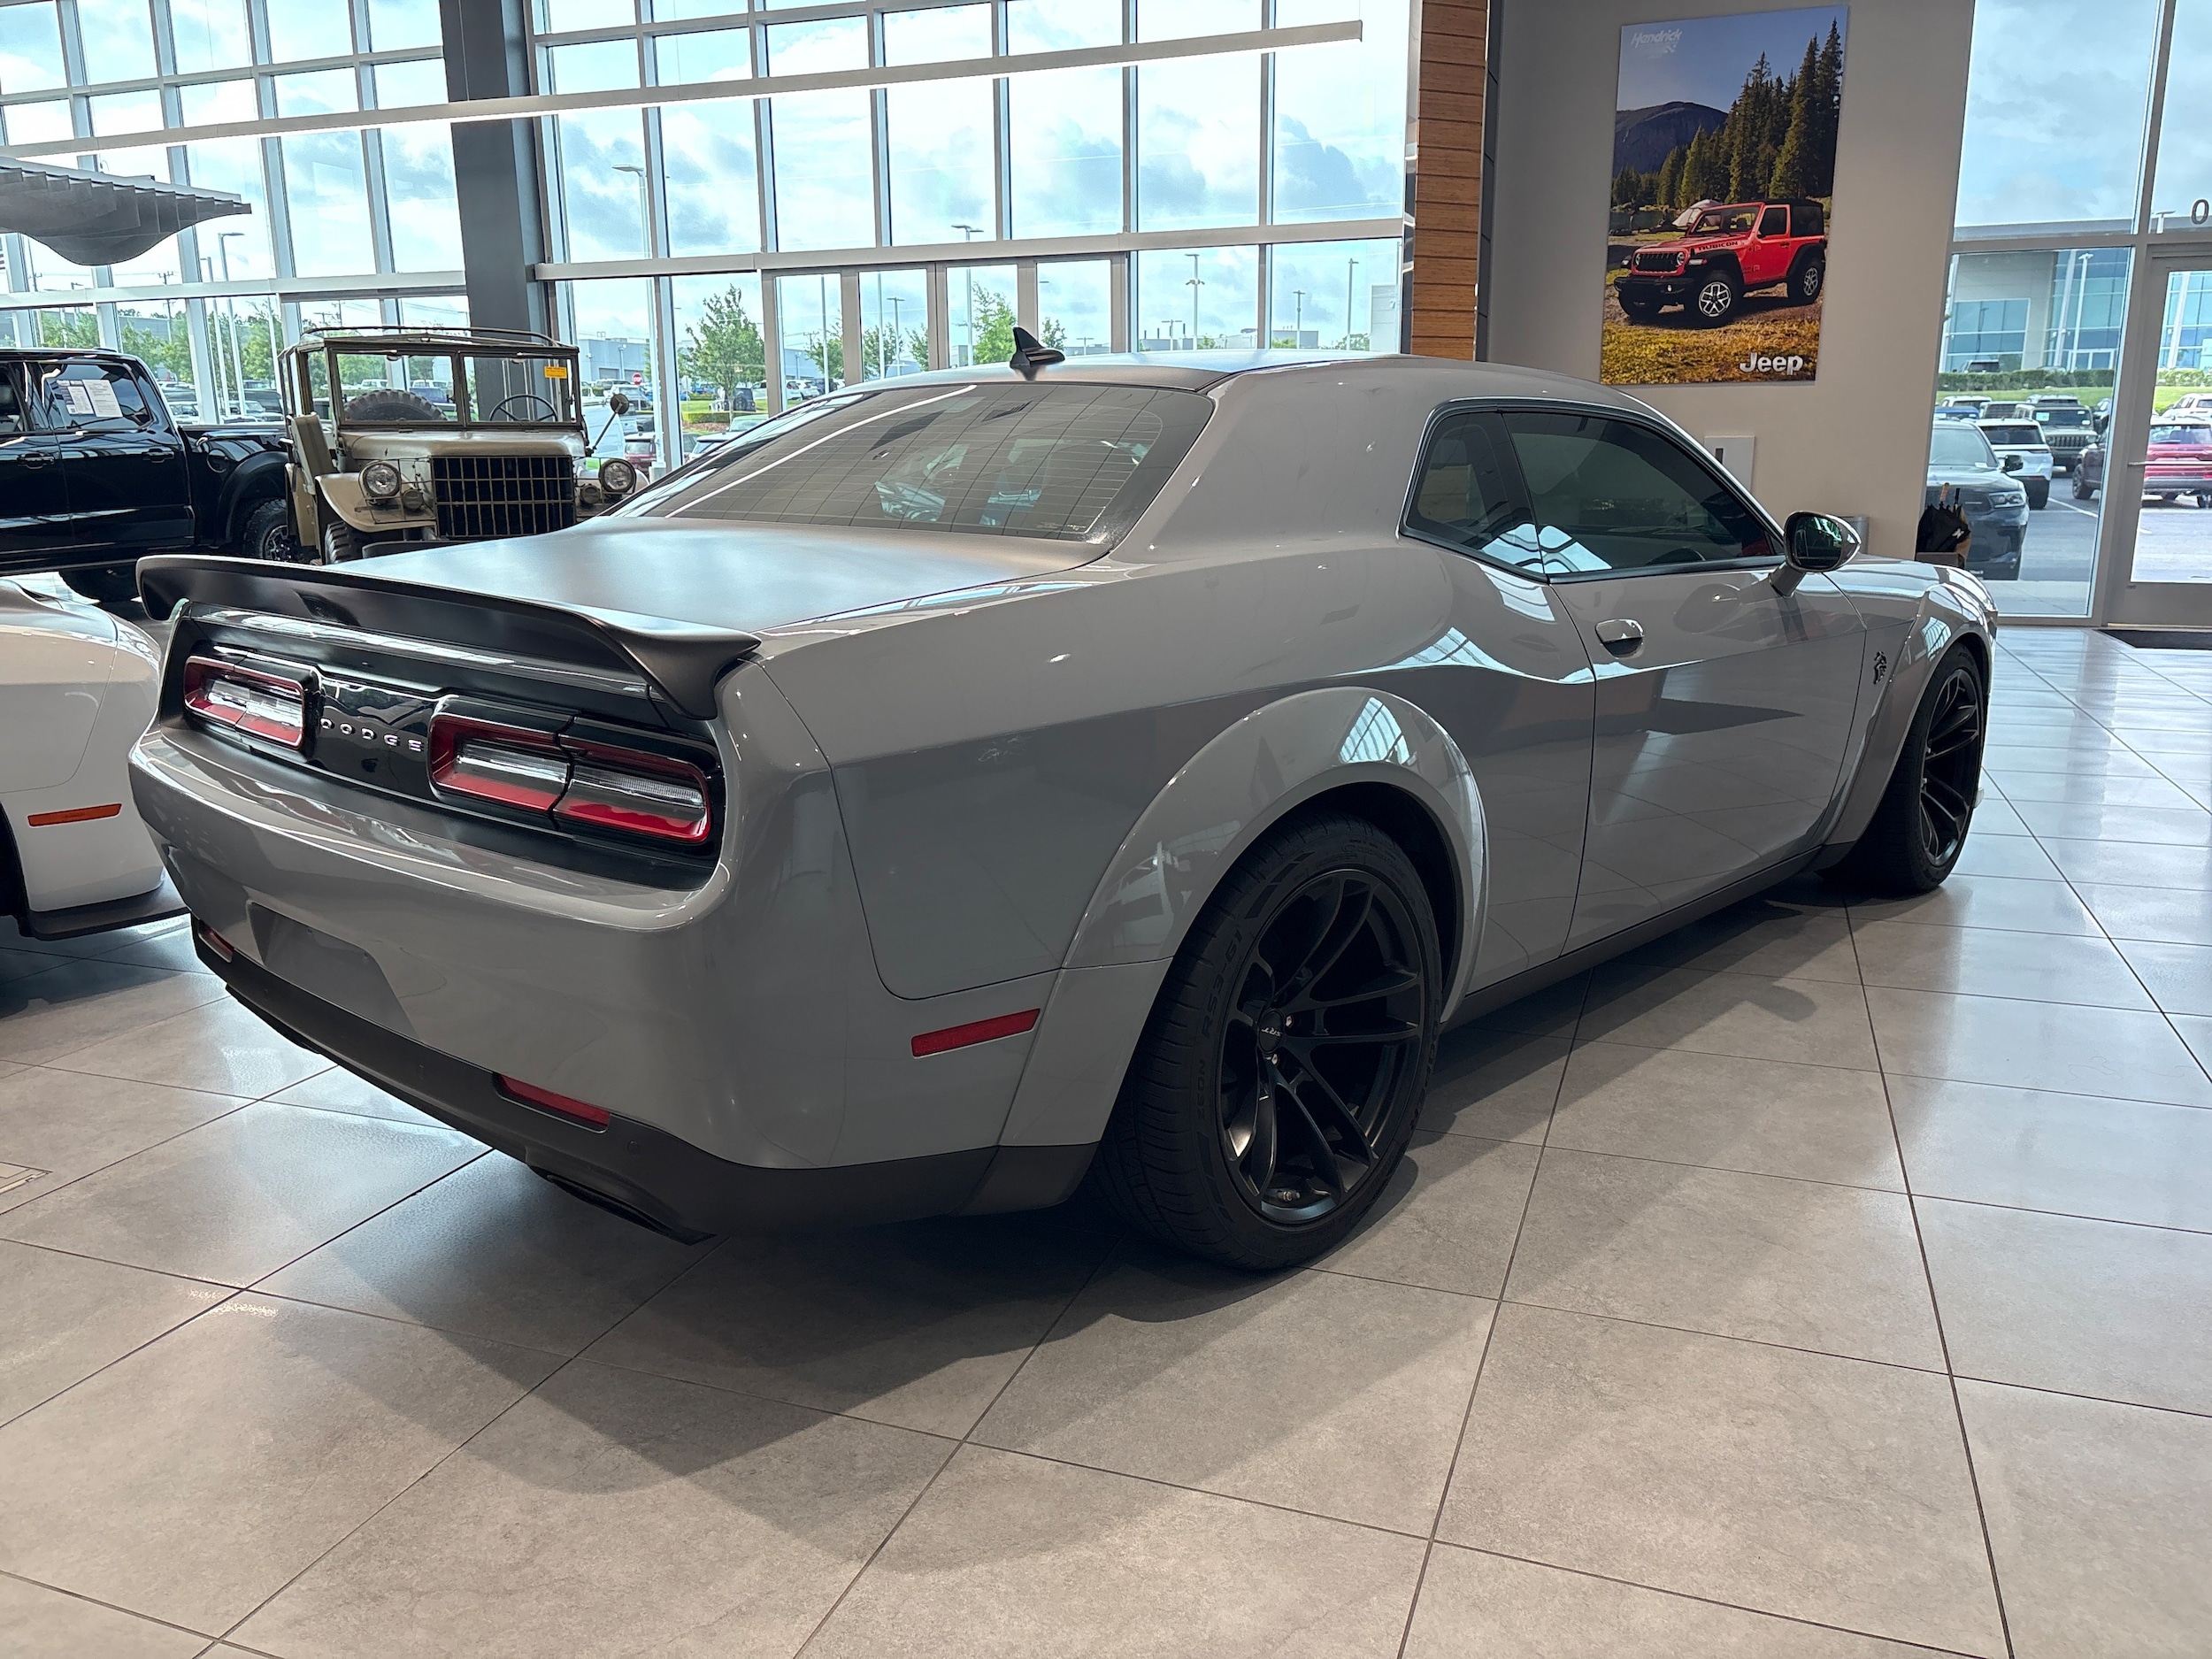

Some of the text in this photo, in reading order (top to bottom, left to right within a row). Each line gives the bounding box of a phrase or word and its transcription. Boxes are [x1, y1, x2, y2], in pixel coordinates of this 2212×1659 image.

[1631, 28, 1683, 49] Hendrick
[1699, 241, 1739, 251] RUBICON
[1740, 352, 1803, 376] Jeep
[319, 718, 424, 752] DODGE
[1196, 1059, 1206, 1121] ZEON
